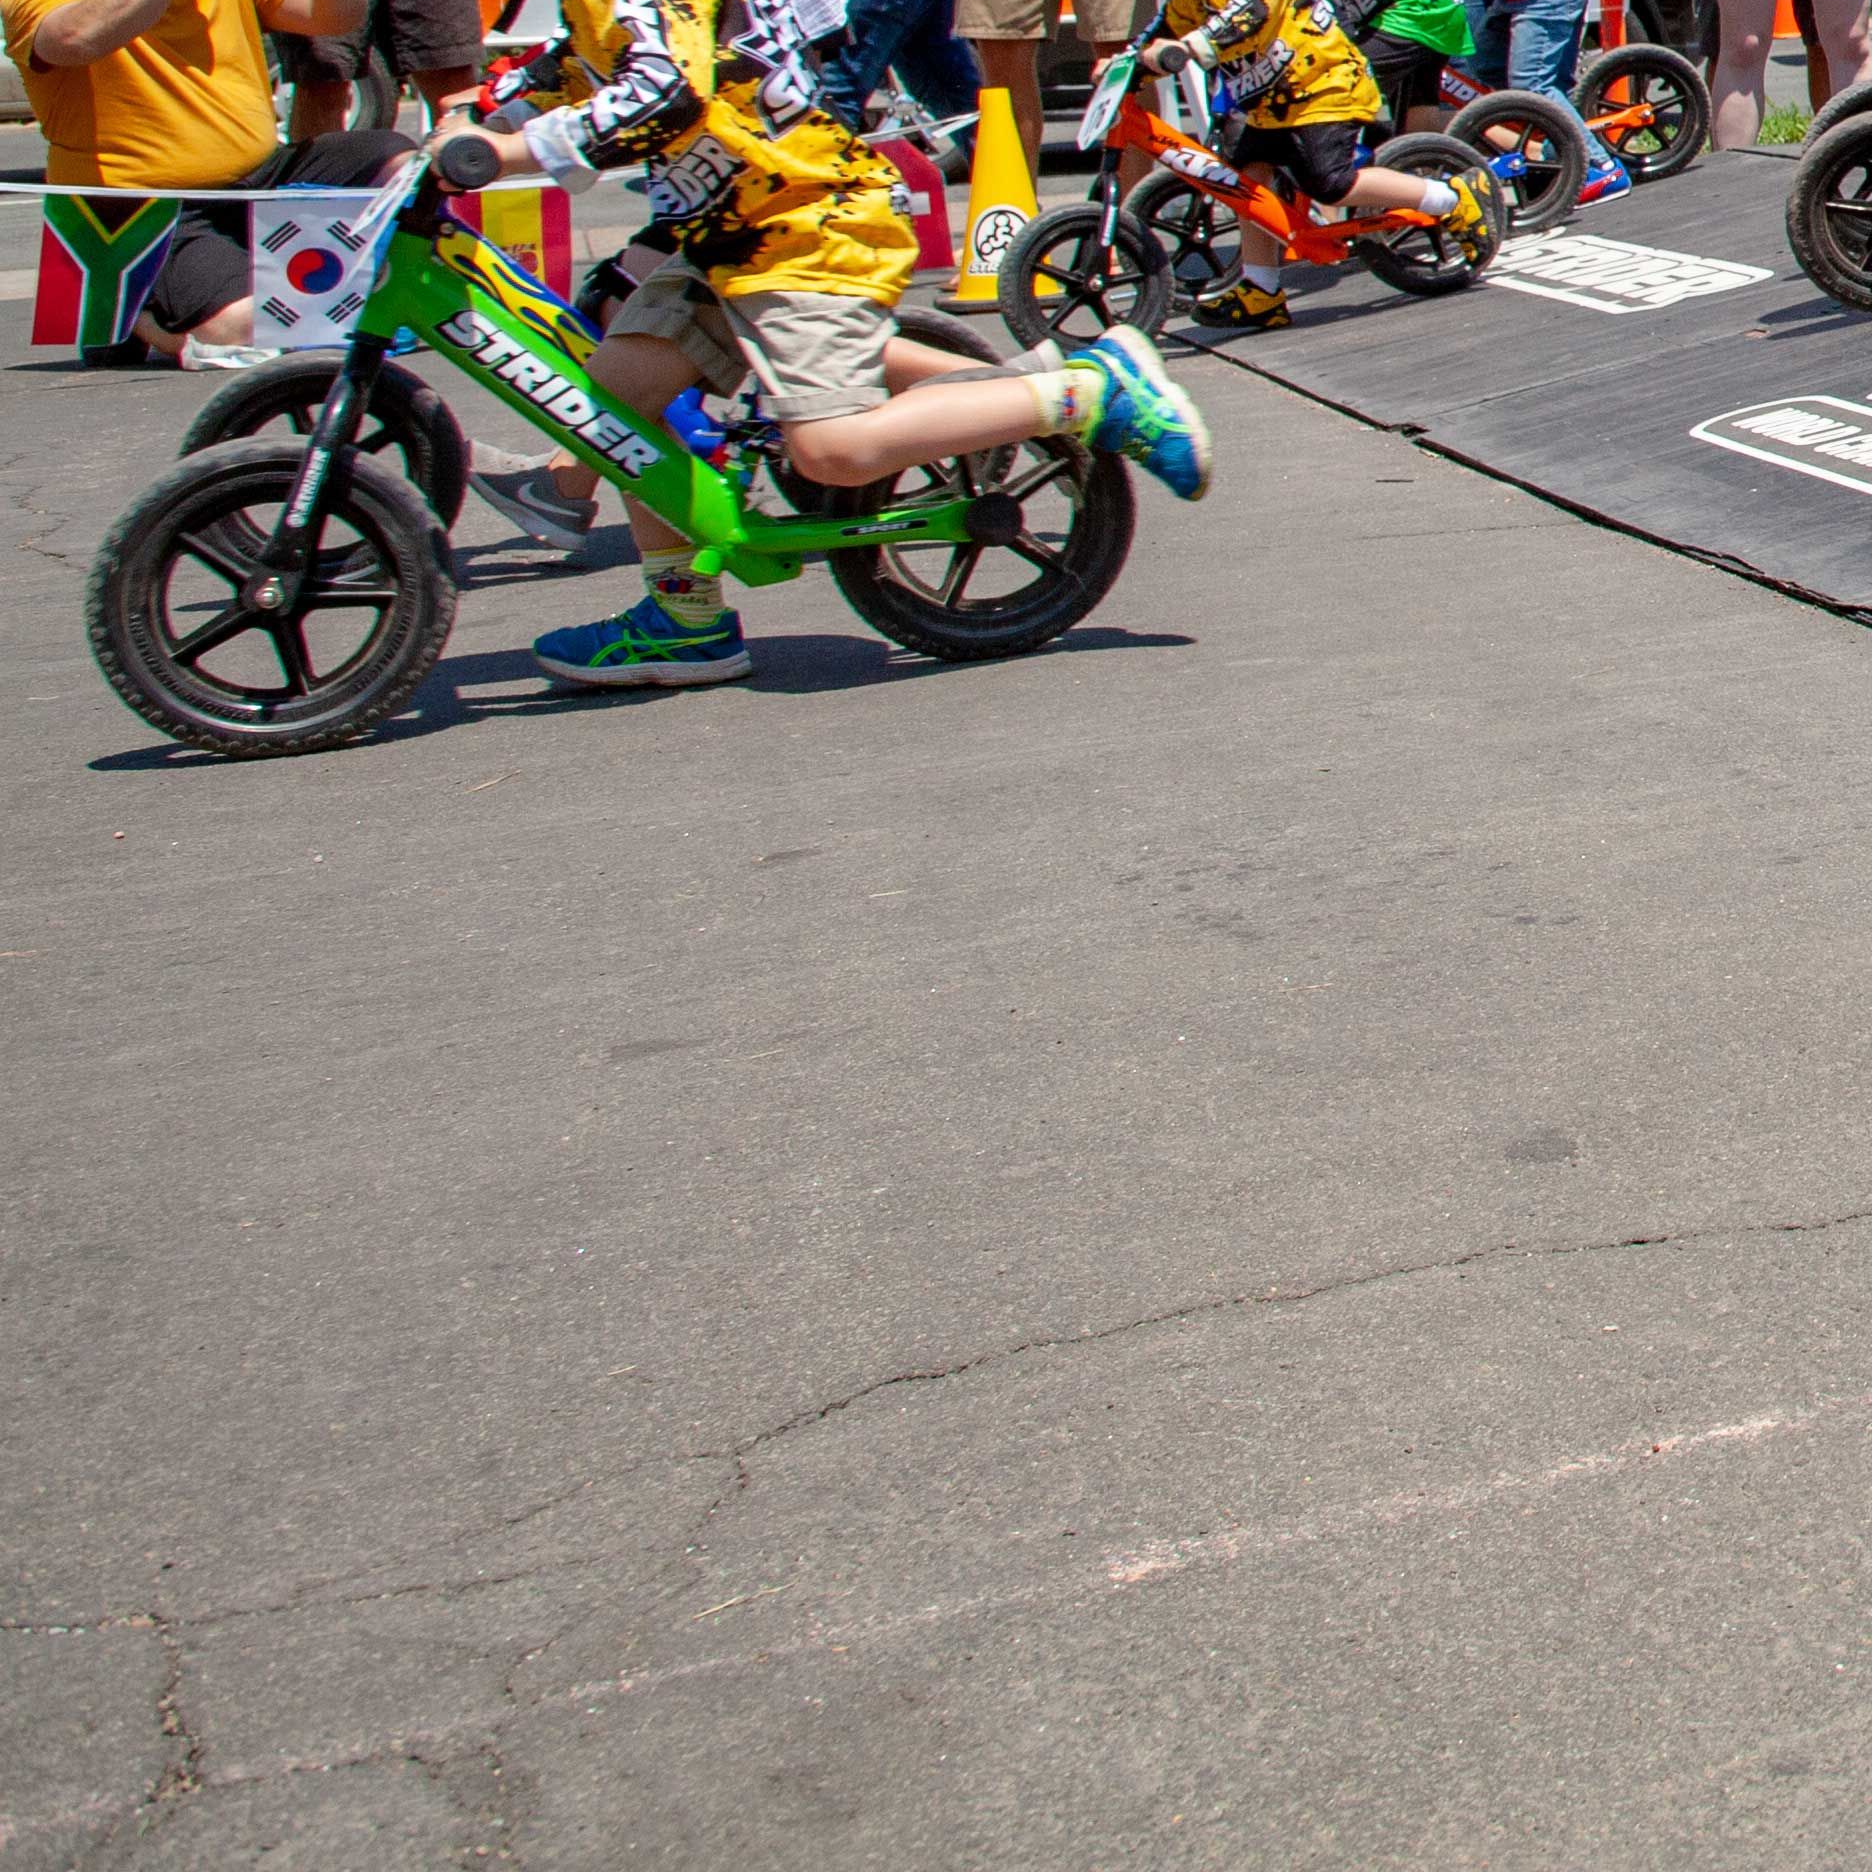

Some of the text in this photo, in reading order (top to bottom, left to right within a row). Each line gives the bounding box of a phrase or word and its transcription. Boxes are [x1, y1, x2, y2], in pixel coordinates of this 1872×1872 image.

[1159, 148, 1239, 187] KTM
[436, 308, 664, 479] STRIDER
[1731, 407, 1863, 446] WORLD
[296, 448, 332, 514] STRIDER
